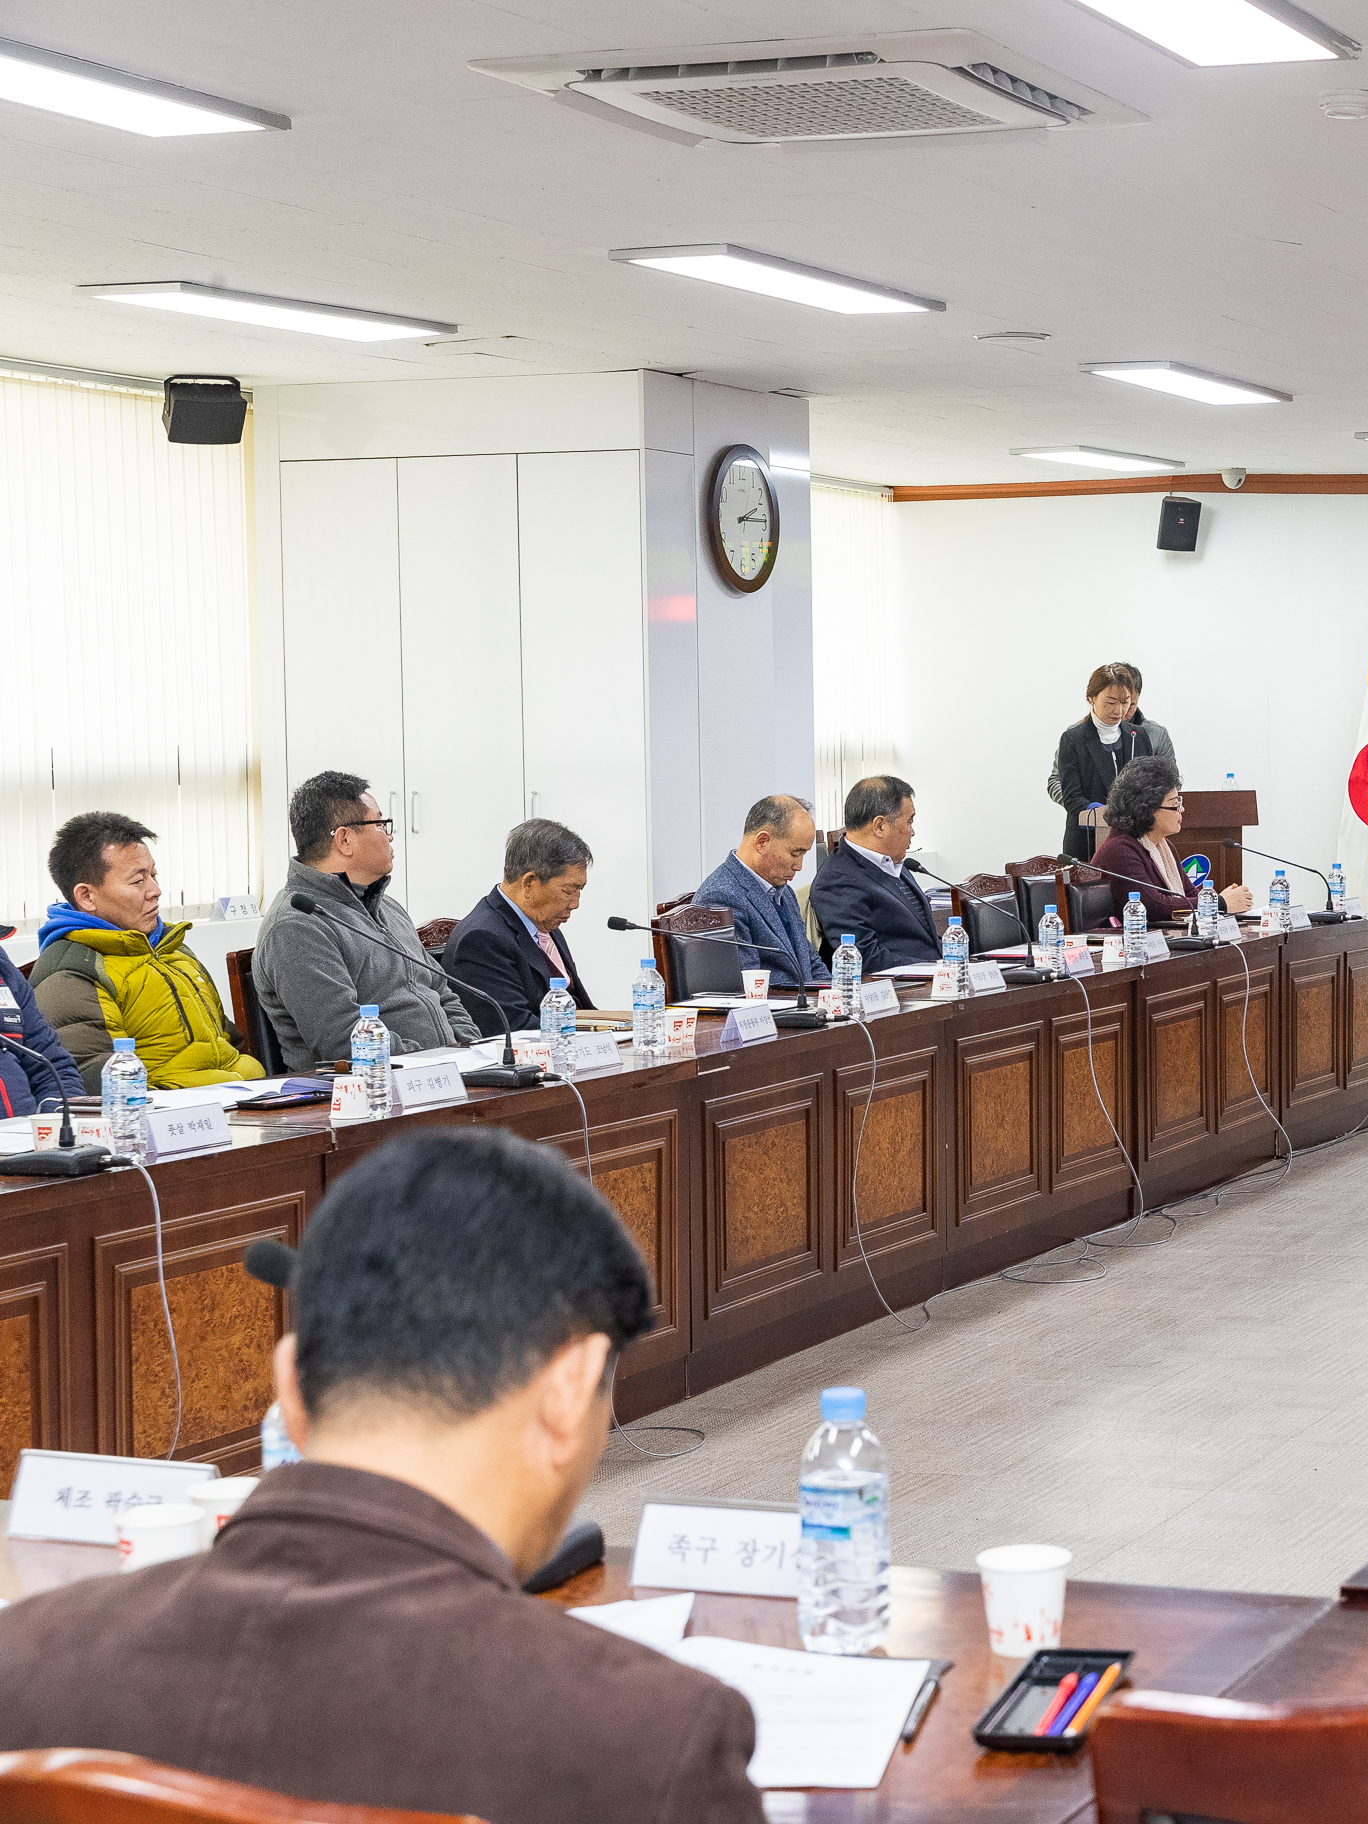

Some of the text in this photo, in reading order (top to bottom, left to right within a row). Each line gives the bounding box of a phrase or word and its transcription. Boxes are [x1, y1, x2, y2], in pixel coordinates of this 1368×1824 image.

[167, 1122, 185, 1137] 풋살
[667, 1533, 800, 1571] 족구 장기
